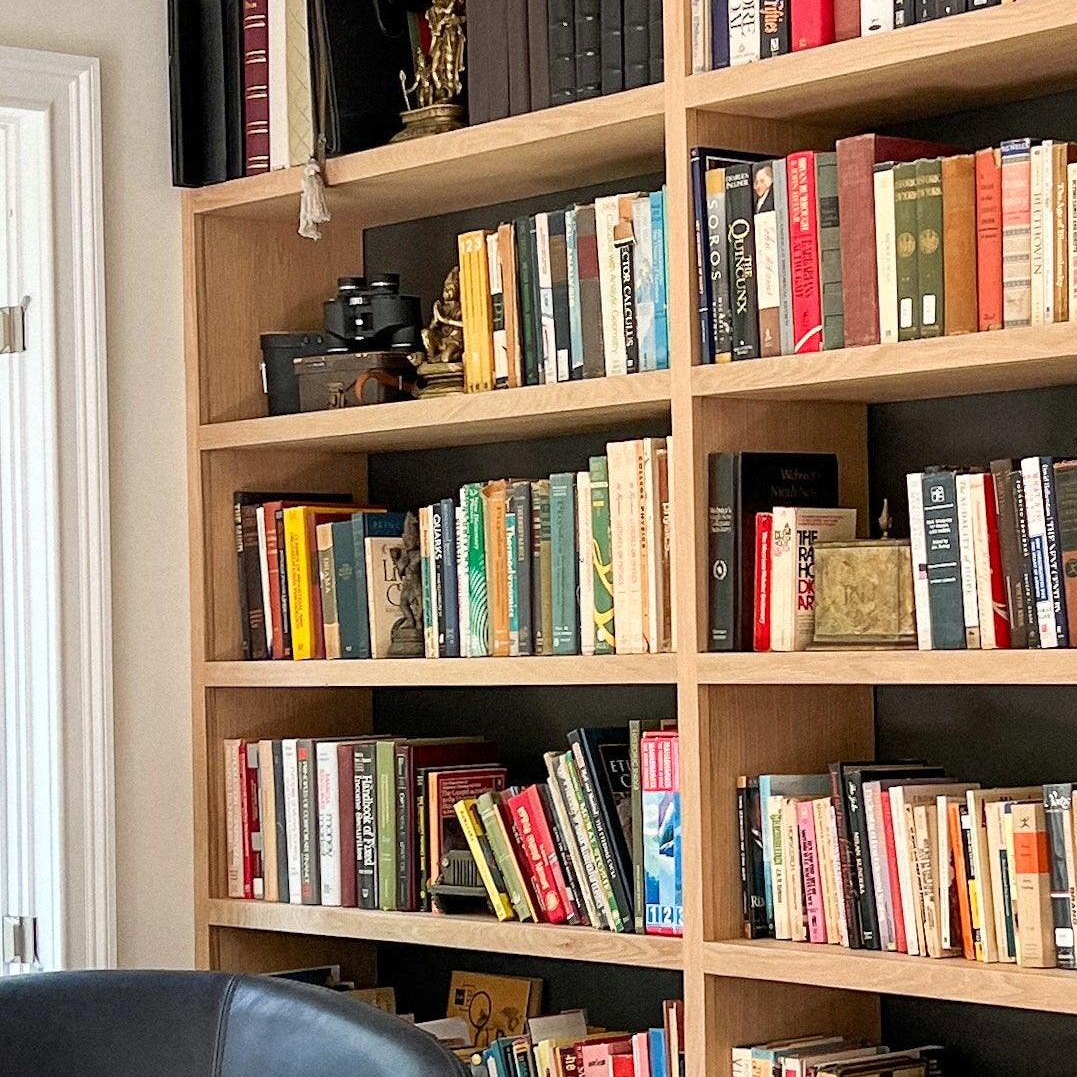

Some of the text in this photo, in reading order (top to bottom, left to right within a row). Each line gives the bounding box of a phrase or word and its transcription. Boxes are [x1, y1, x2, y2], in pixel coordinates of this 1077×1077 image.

[706, 197, 722, 281] SOROS
[1032, 192, 1042, 275] BEETHOVEN
[727, 218, 750, 315] QUINCUNX
[744, 255, 752, 279] THE
[607, 253, 619, 353] with Analytic Geometry
[622, 285, 634, 347] CALCULUS
[1042, 463, 1050, 482] David
[434, 513, 443, 560] QUARKS
[796, 529, 818, 545] THE
[1046, 521, 1056, 543] THE
[323, 557, 331, 593] DRAMA
[506, 525, 516, 617] Thermodynamics
[964, 565, 972, 596] HOPE
[325, 813, 334, 857] money
[354, 775, 364, 861] Income Securities
[362, 775, 374, 865] Handbook of Fixed
[853, 831, 862, 856] MILAN
